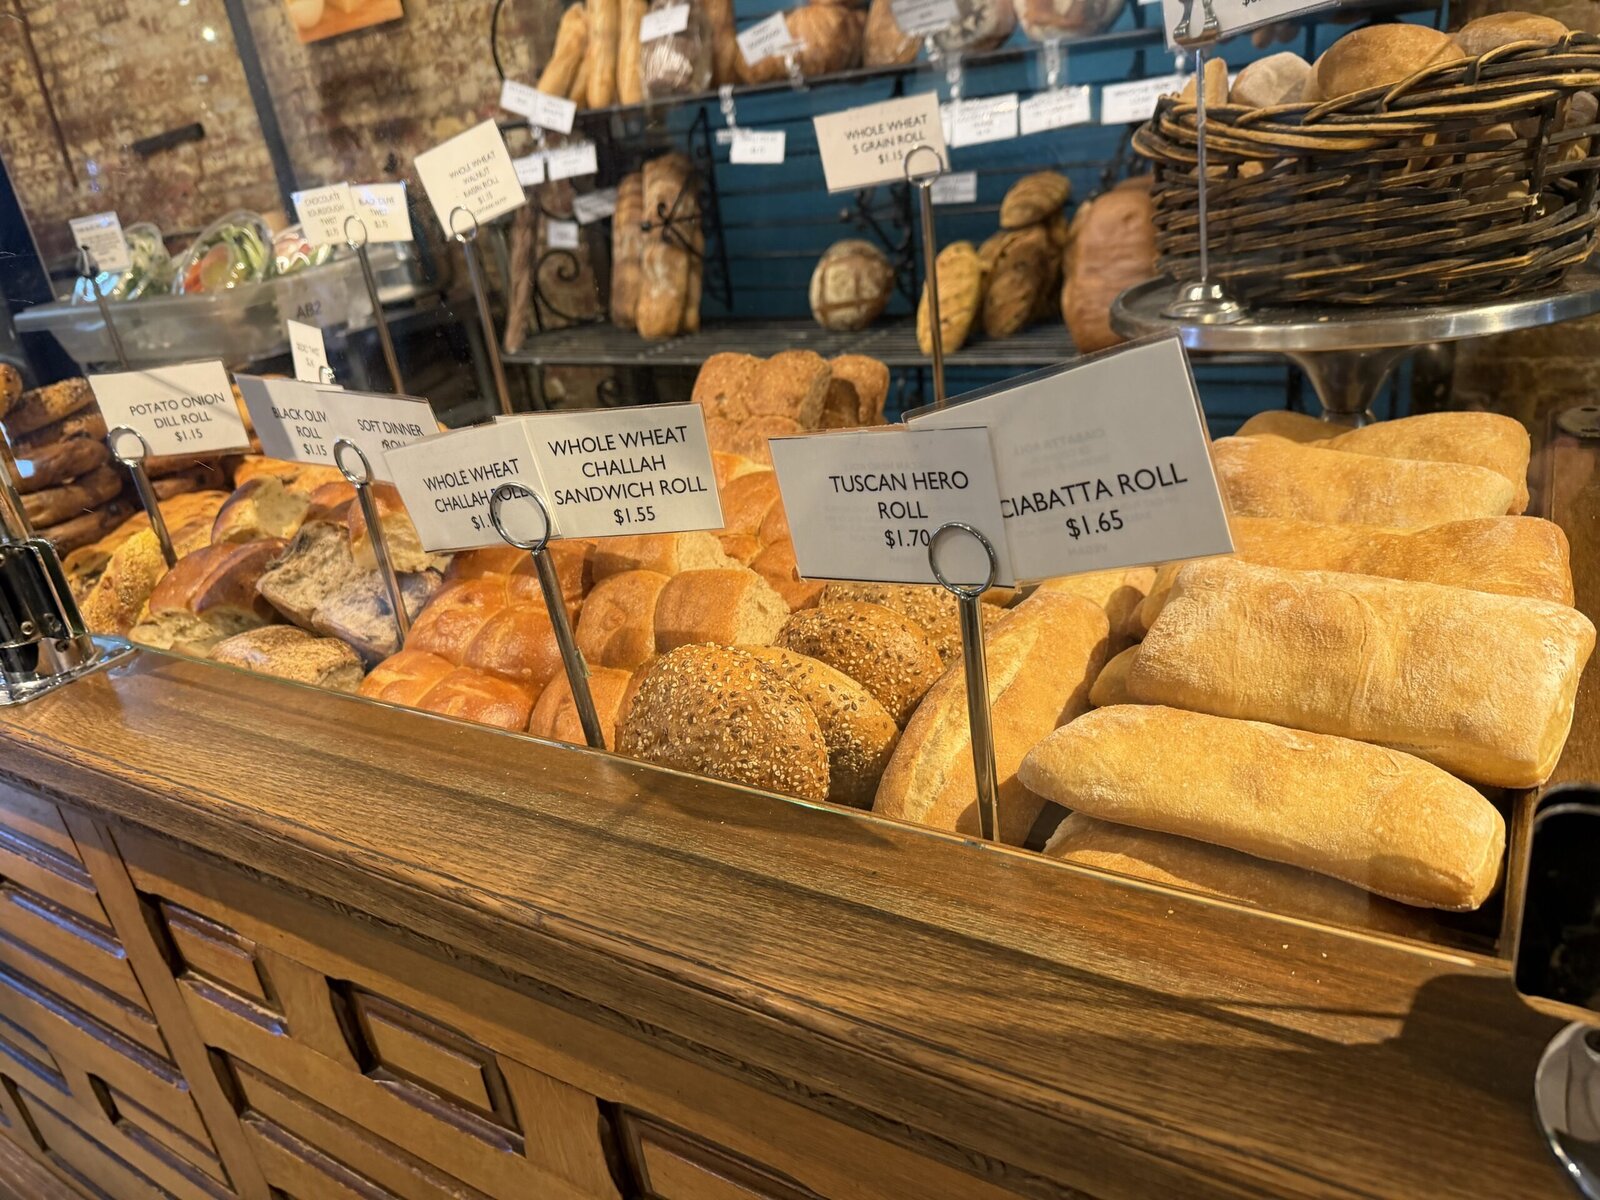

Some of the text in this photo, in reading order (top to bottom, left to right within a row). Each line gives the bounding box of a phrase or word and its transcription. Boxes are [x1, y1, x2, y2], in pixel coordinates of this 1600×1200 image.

[845, 113, 928, 141] WHOLE WHEAT
[861, 136, 895, 153] GRAIN
[898, 131, 926, 145] ROLL
[471, 150, 496, 168] WHEAT
[129, 392, 225, 416] POTATO ONION
[271, 406, 327, 423] BLACK OLIV
[154, 411, 213, 429] DILL ROLL
[357, 418, 425, 437] SOFT DINNER
[175, 429, 204, 443] $1.15
[296, 425, 322, 440] ROLL
[548, 425, 687, 457] WHOLE WHEAT
[303, 443, 328, 457] $1.15
[423, 458, 519, 492] WHOLE WHEAT
[581, 454, 666, 478] CHALLAH
[554, 476, 708, 505] SANDWICH ROLL
[829, 470, 969, 493] TUSCAN HERO
[999, 478, 1113, 519] CIABATTA
[1117, 463, 1188, 495] ROLL
[435, 488, 493, 513] CHALLAH
[877, 501, 929, 519] ROLL
[471, 512, 496, 532] $1.1
[613, 506, 656, 526] $1.55
[1065, 509, 1124, 540] $1.65
[884, 529, 931, 549] $1.70
